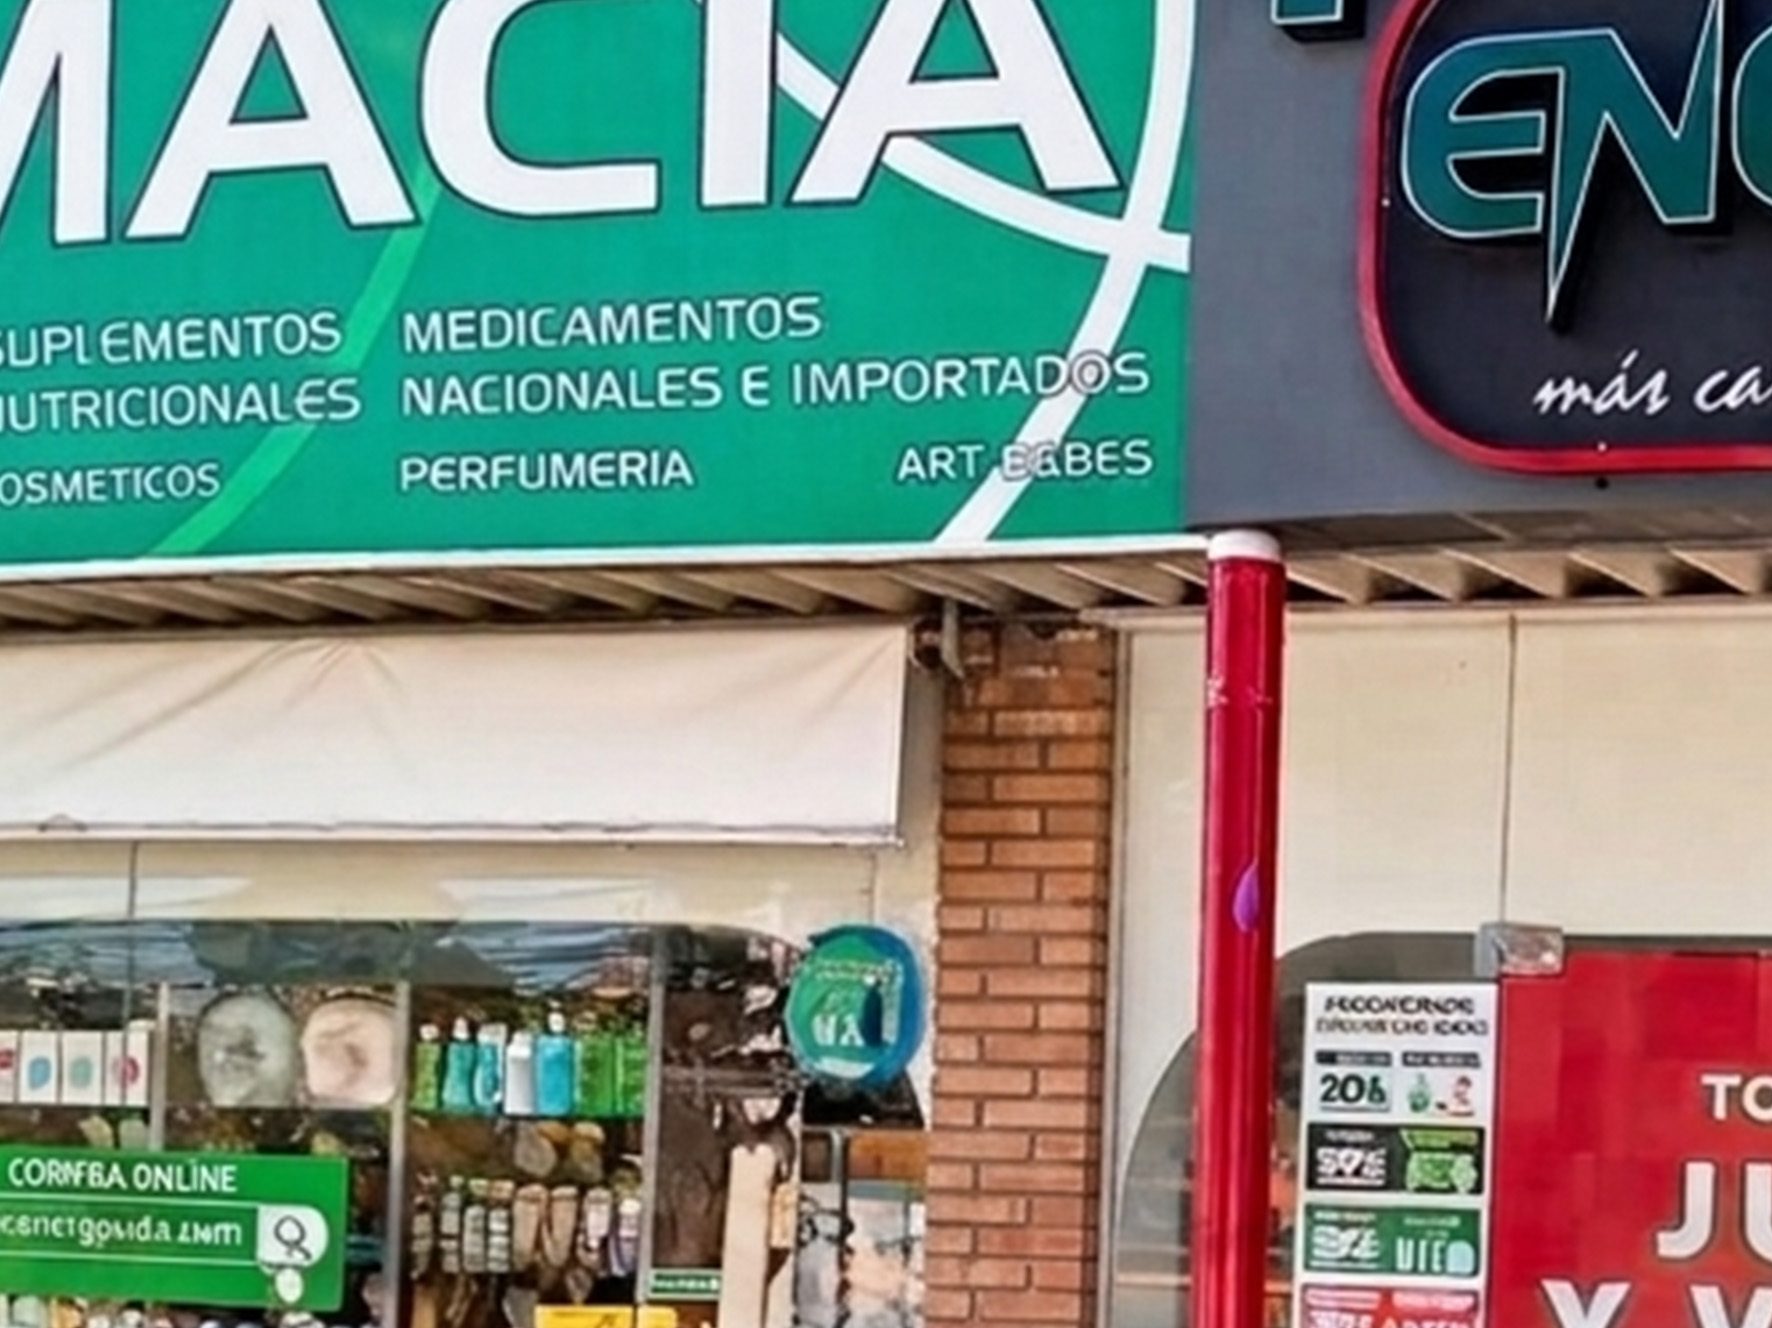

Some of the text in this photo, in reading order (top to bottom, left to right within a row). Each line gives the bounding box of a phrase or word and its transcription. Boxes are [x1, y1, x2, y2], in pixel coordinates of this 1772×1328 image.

[0, 311, 342, 367] UPLEMENTOS
[403, 296, 823, 353] MEDICAMENTOS
[0, 376, 362, 432] UTRICIONALES
[402, 352, 1150, 416] NACIONALES E IMPORTADOS
[1533, 350, 1670, 415] más
[400, 449, 694, 491] PERFUMERIA
[897, 445, 985, 481] ART
[132, 1159, 238, 1193] ONLINE
